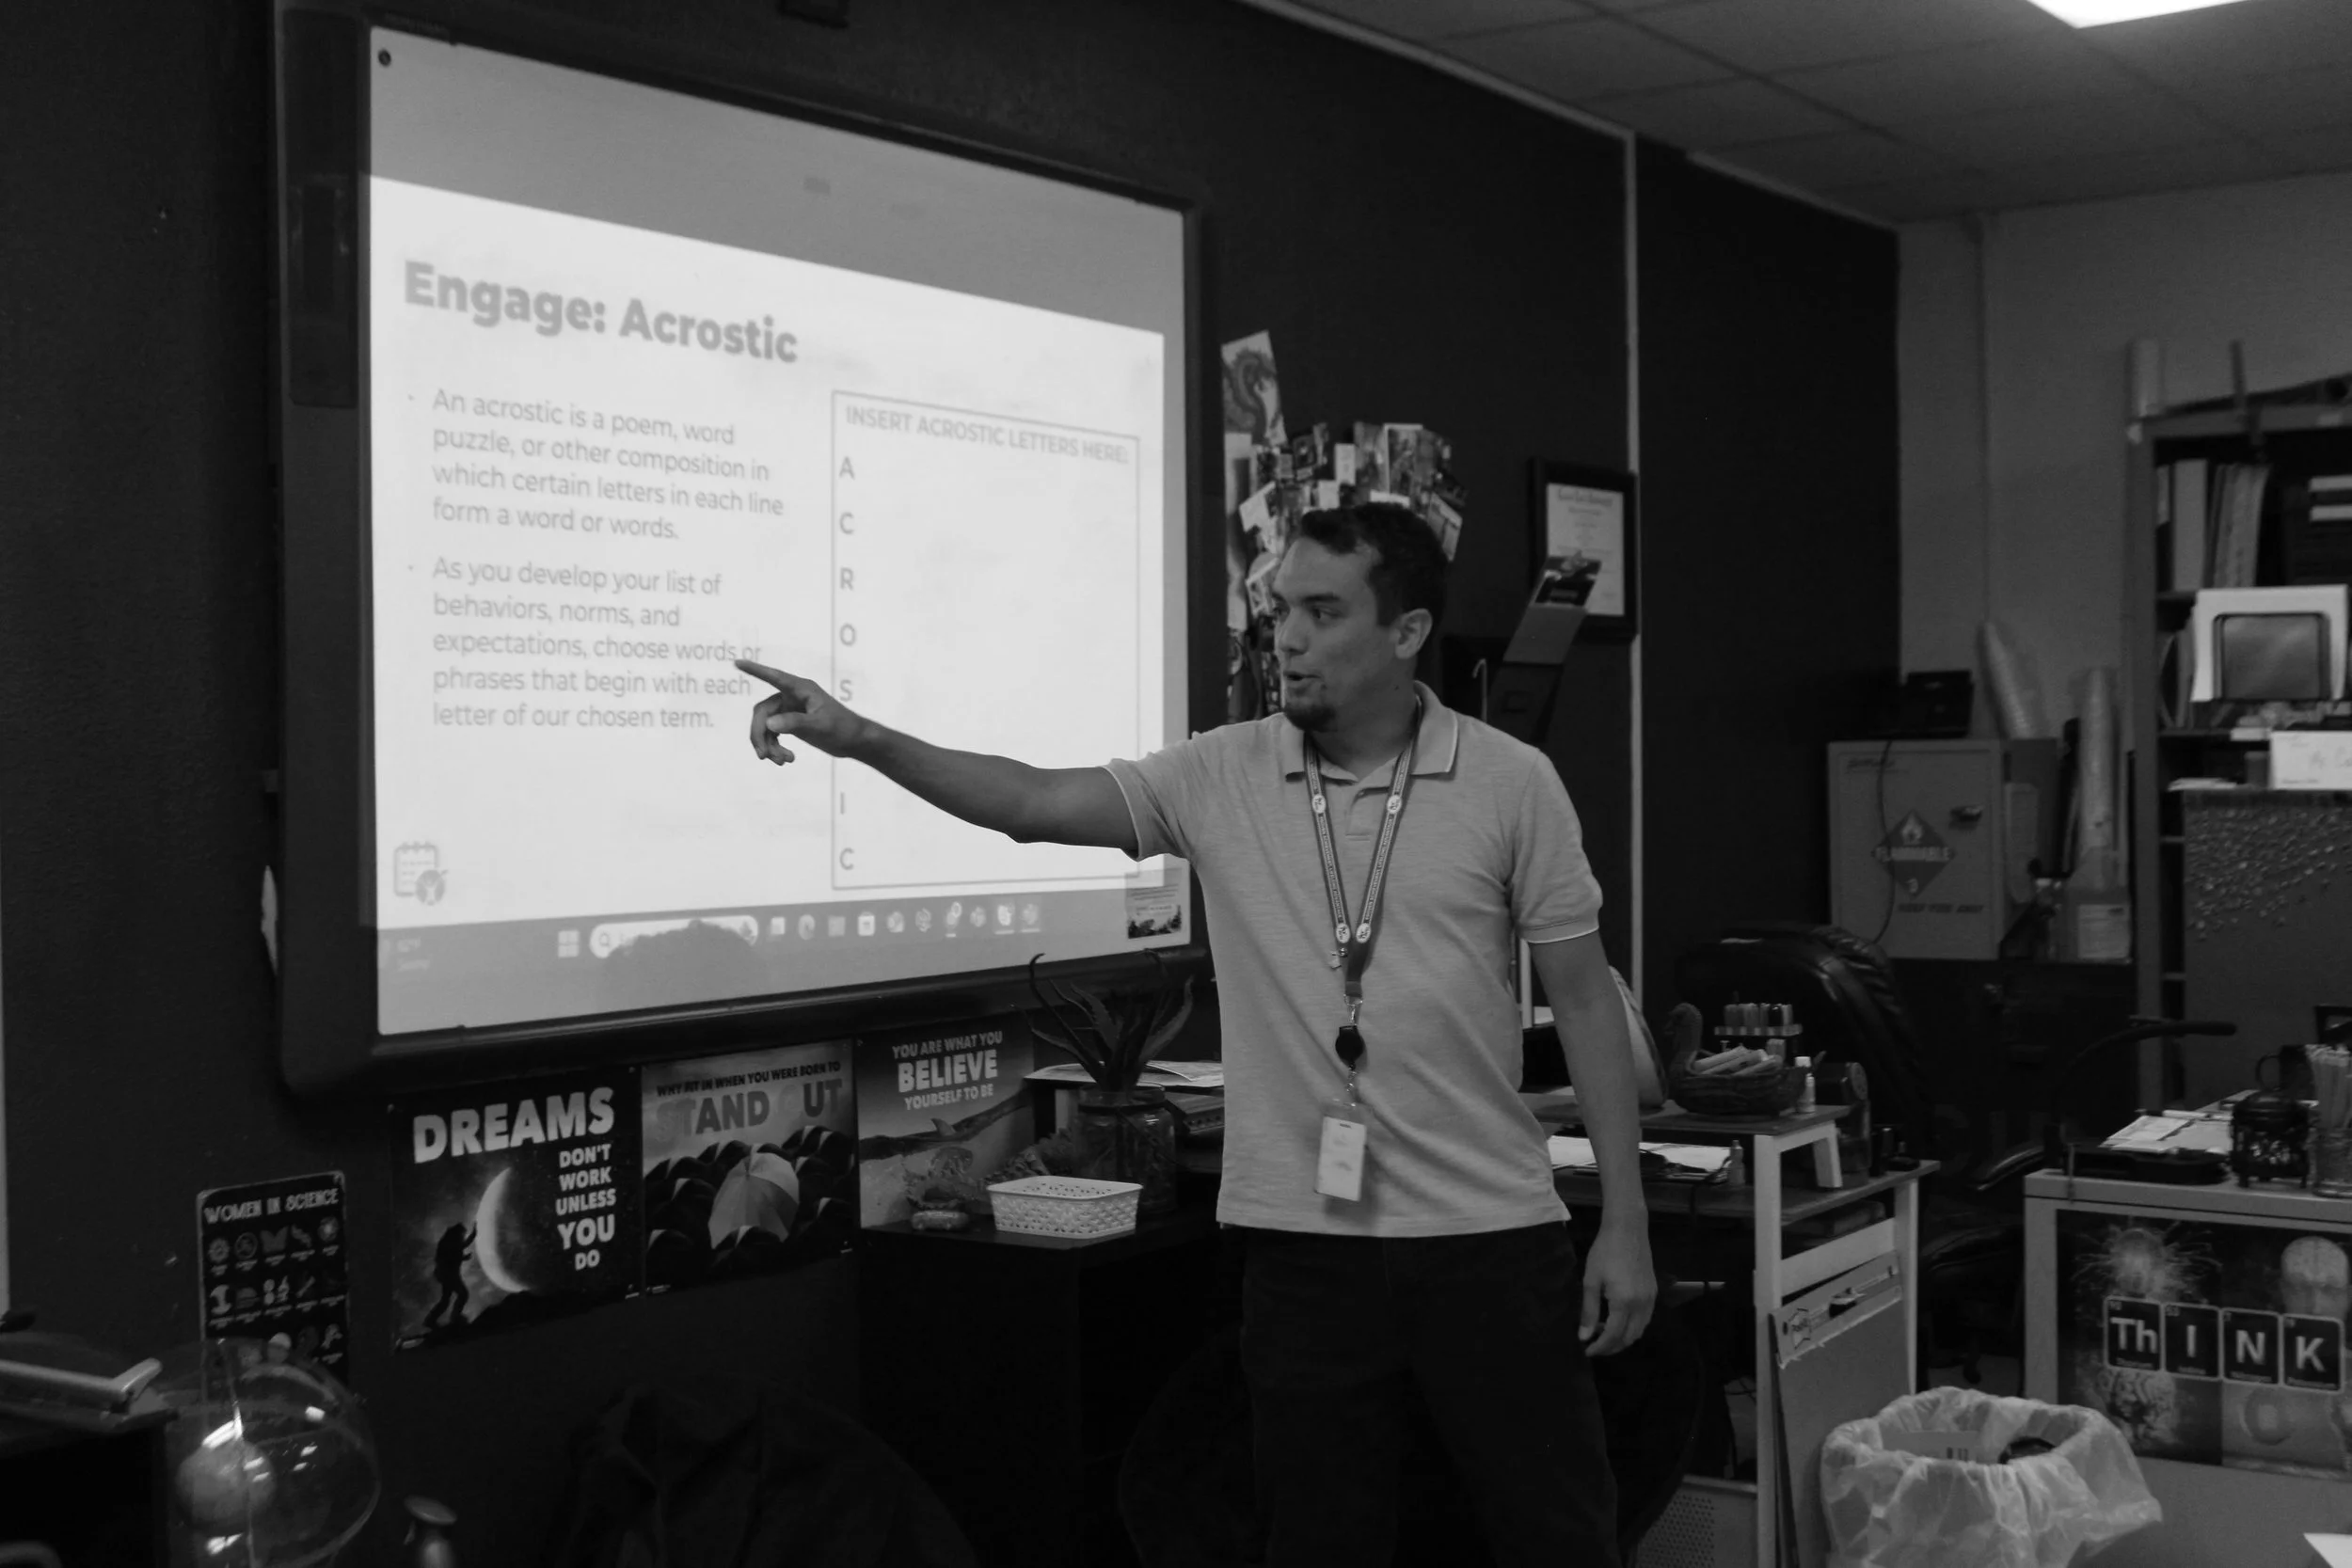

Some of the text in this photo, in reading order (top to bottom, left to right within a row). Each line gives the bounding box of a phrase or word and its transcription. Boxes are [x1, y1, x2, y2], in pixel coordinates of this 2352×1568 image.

[404, 261, 798, 363] Engage: Acrostic
[433, 388, 735, 445] An acrostic is a poem, word
[847, 405, 913, 432] INSERT
[916, 416, 1005, 447] ACROSTIC
[1009, 431, 1078, 457] LETTERS
[433, 428, 769, 482] puzzle, or other composition in
[839, 457, 855, 480] A
[432, 463, 784, 515] which certain letters in each line
[433, 497, 679, 539] form a word or words.
[839, 512, 854, 535] C
[433, 556, 722, 594] As you develop your list of
[840, 568, 854, 591] R
[434, 593, 679, 628] behaviors, norms, and
[433, 631, 587, 658] expectations,
[594, 636, 669, 659] choose
[675, 641, 736, 661] words
[839, 624, 856, 646] O
[434, 667, 750, 697] phrases that begin with each
[839, 679, 853, 703] S
[433, 703, 714, 727] letter of our chosen term.
[839, 847, 854, 870] C
[892, 1031, 1003, 1059] YOU ARE WHAT YOU
[657, 1061, 840, 1096] WHY FIT IN WHEN YOU WERE BORN TO
[898, 1049, 998, 1093] BELIEVE
[657, 1078, 842, 1142] STAND OUT
[904, 1084, 993, 1110] YOURSELF TO BE
[413, 1086, 615, 1164] DREAMS
[559, 1144, 612, 1168] DON'T
[559, 1166, 612, 1191] WORK
[203, 1188, 339, 1224] WOMEN IN SCIENCE
[555, 1189, 616, 1215] UNLESS
[557, 1214, 615, 1249] YOU
[575, 1249, 600, 1271] DO
